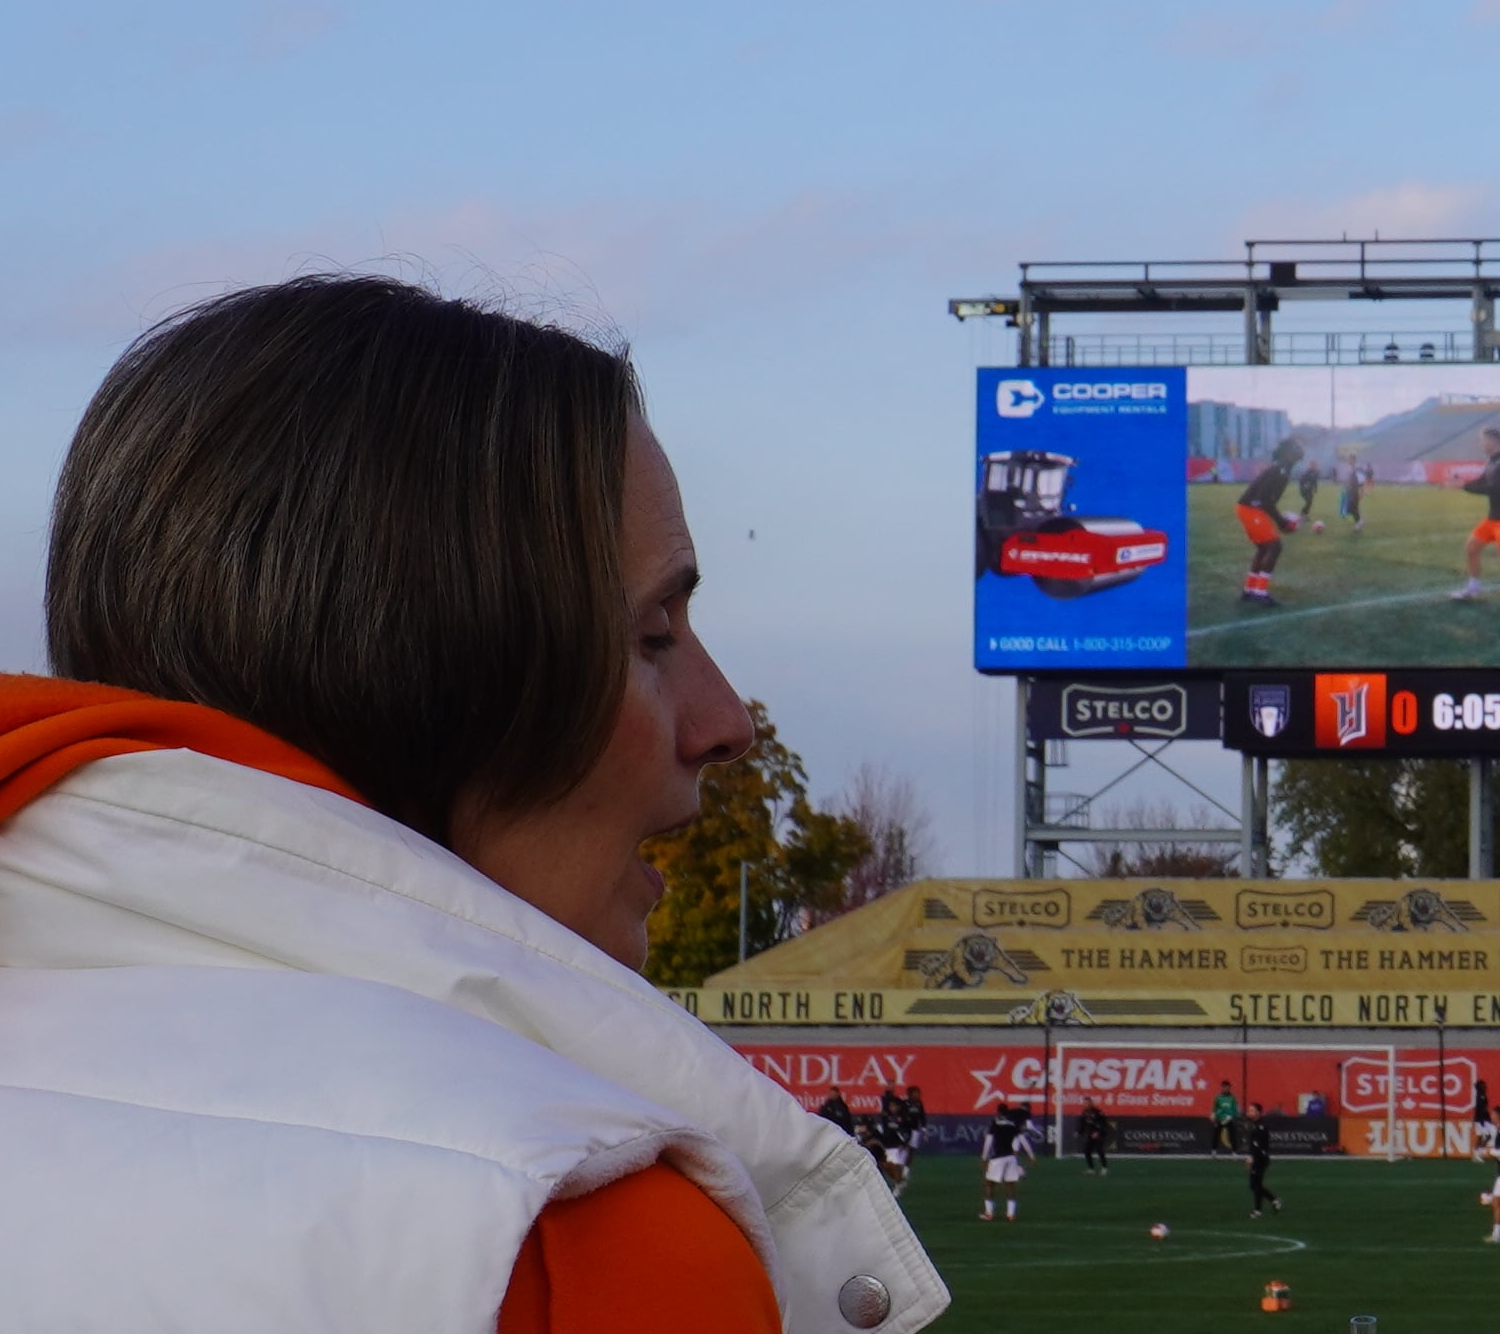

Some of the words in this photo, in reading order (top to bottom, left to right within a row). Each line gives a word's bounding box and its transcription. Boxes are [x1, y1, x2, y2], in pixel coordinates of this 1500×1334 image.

[1052, 382, 1167, 399] COOPER
[1036, 636, 1069, 651] CALL
[1075, 698, 1174, 721] STELCO
[1391, 689, 1418, 735] 0
[983, 899, 1060, 917] STELCO
[1247, 899, 1324, 918] STELCO
[1061, 948, 1114, 968] THE
[1120, 949, 1228, 969] HAMMER
[1248, 953, 1301, 965] STELCO
[1320, 949, 1369, 969] THE
[1379, 950, 1488, 970] HAMMER
[723, 992, 810, 1019] NORTH
[834, 992, 884, 1019] END
[1230, 994, 1334, 1023] STELCO
[747, 1054, 917, 1086] NDLAY
[1011, 1057, 1199, 1090] CARSTAR
[1356, 1073, 1463, 1096] STELCO
[1124, 1130, 1196, 1142] CONESTOGA
[1269, 1130, 1329, 1142] ONESTOGA
